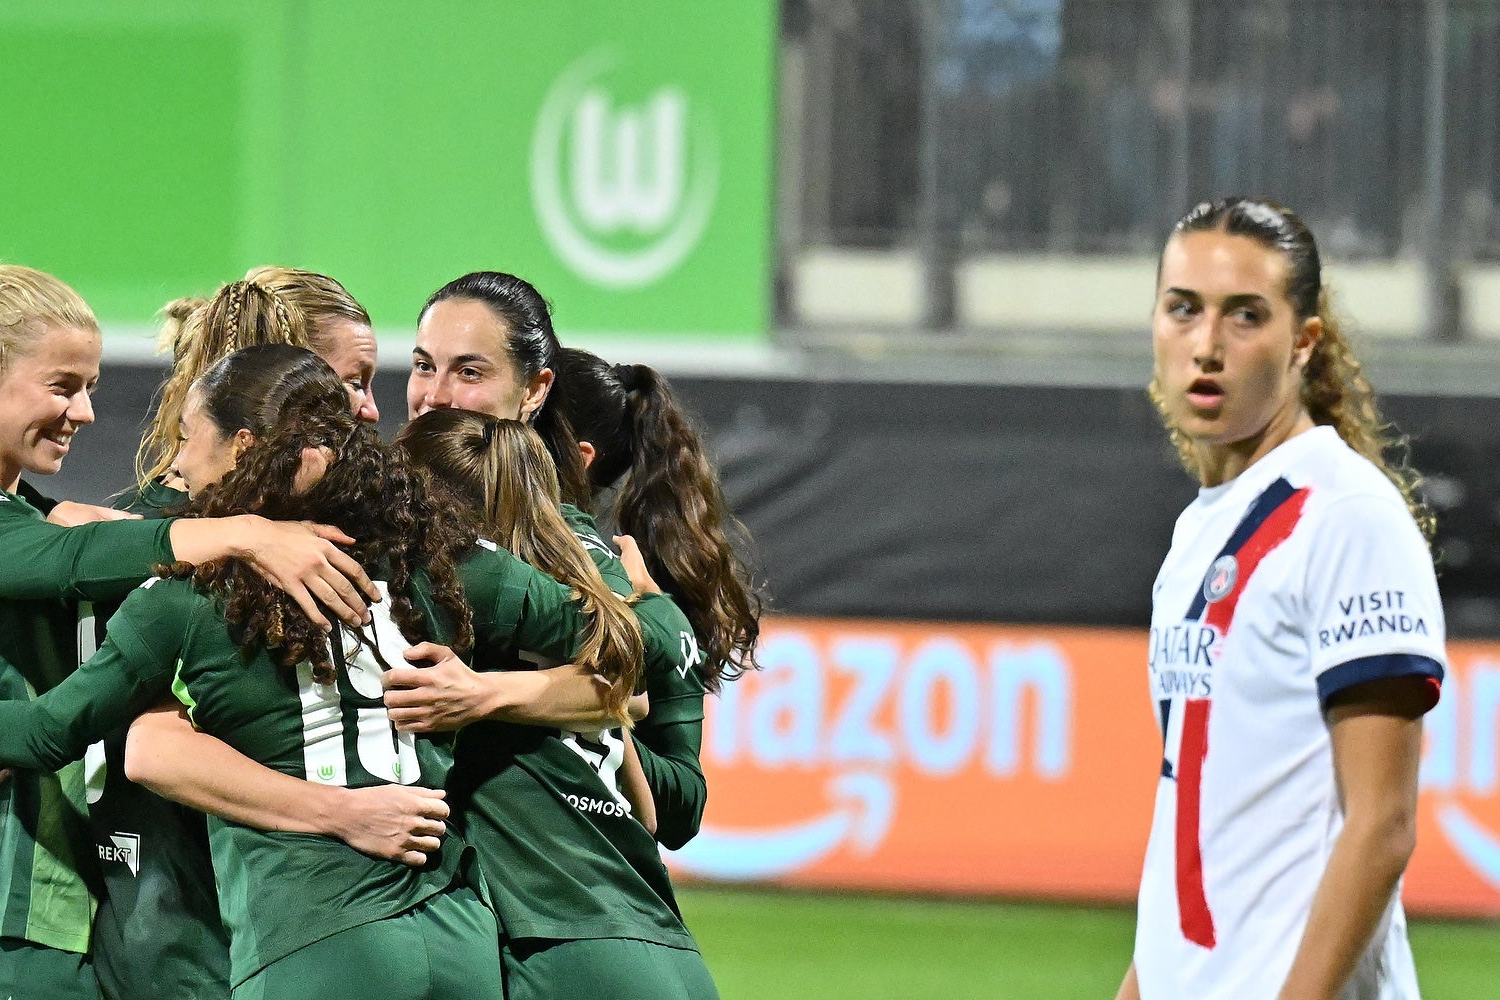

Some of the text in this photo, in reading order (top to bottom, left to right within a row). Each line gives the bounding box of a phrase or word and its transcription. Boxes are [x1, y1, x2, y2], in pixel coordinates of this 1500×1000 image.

[1339, 590, 1404, 615] VISIT
[1319, 614, 1428, 648] RWANDA
[712, 632, 1073, 781] azon
[97, 843, 132, 864] REKT
